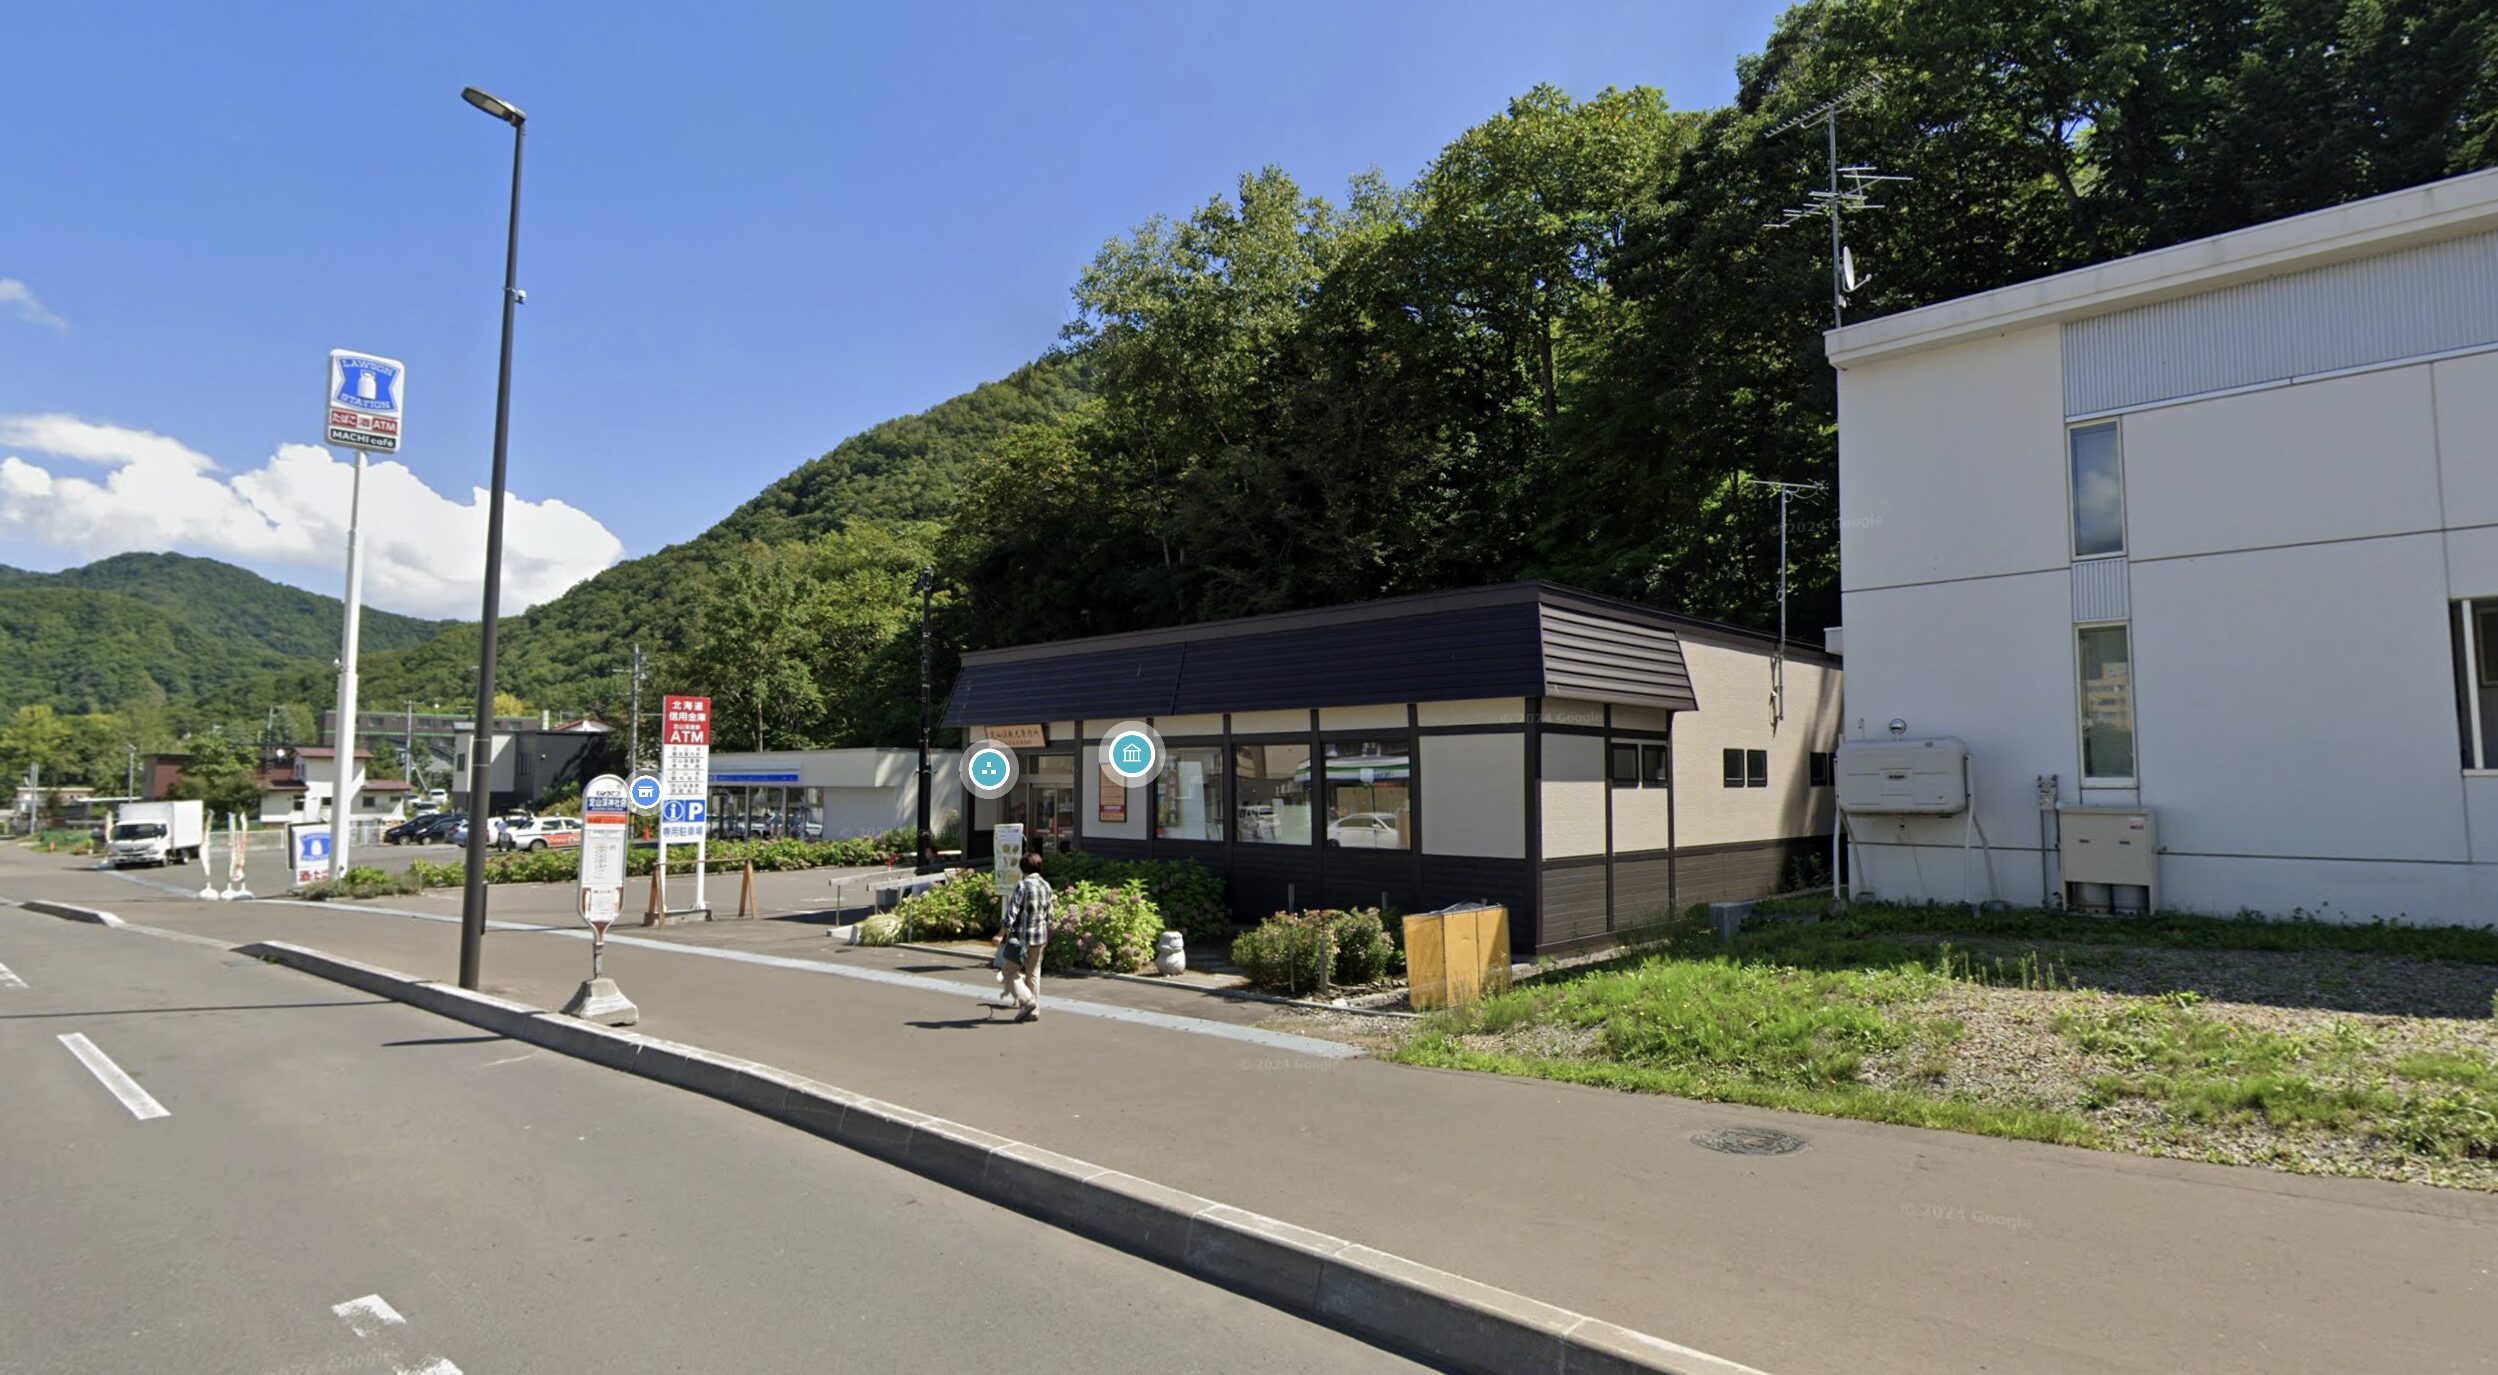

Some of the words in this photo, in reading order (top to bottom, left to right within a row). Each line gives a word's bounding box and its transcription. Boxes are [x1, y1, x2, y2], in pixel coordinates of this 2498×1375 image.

[342, 359, 394, 376] LAWSON
[340, 393, 391, 409] STATION
[373, 420, 397, 432] ATM
[332, 430, 370, 444] MACHI
[672, 701, 704, 711] 北海道
[669, 711, 706, 722] 信用金庫
[670, 730, 704, 744] ATM
[688, 802, 704, 821] P
